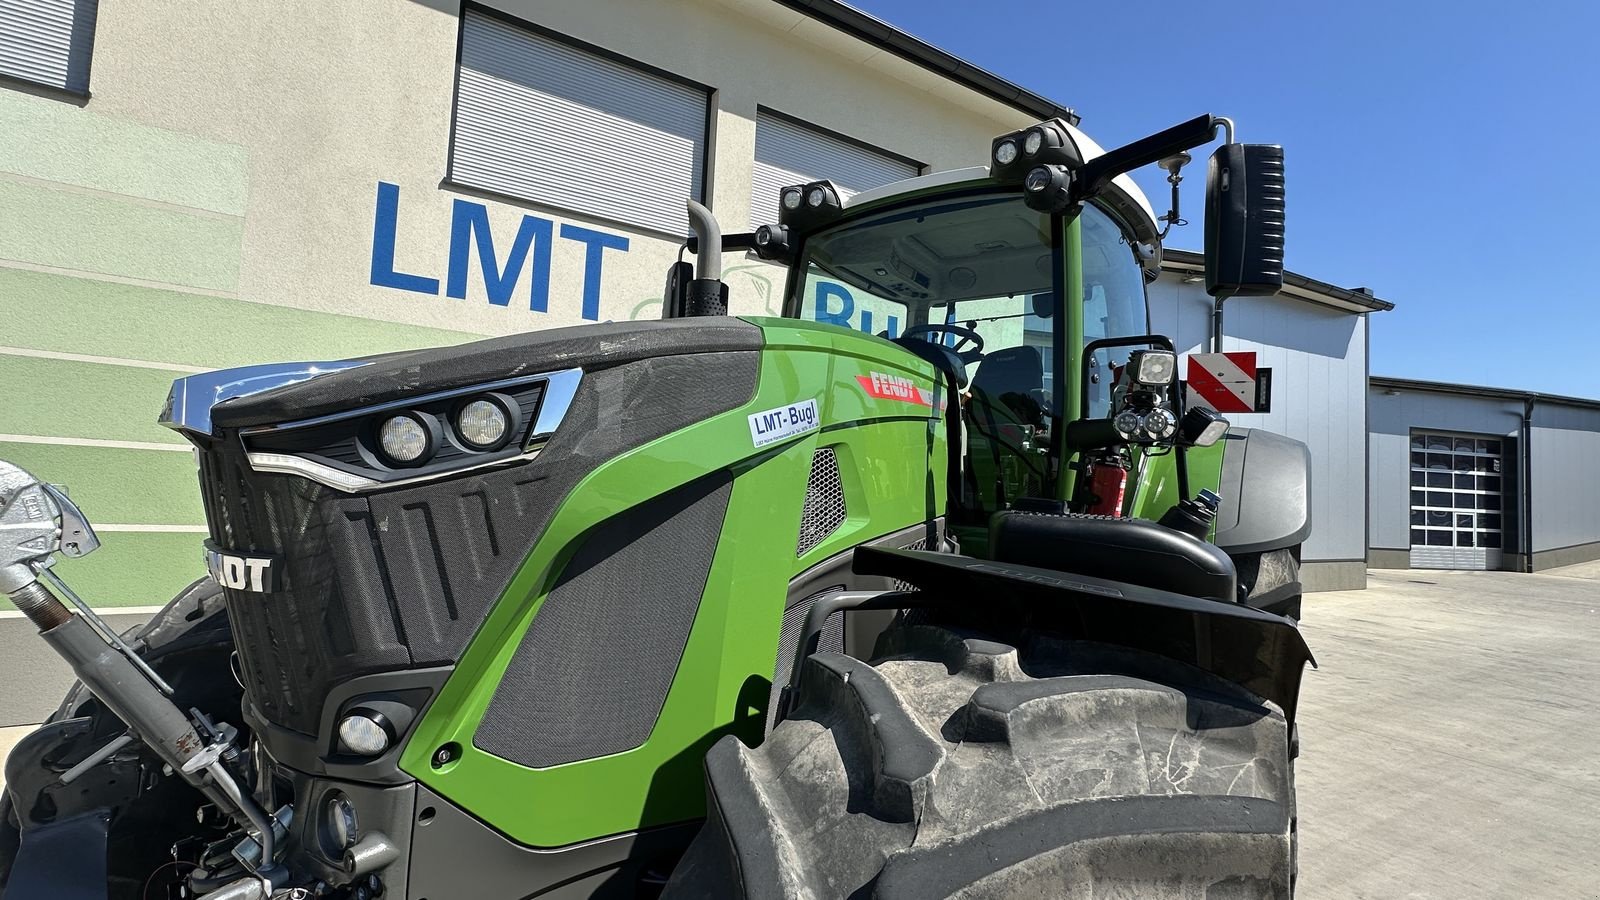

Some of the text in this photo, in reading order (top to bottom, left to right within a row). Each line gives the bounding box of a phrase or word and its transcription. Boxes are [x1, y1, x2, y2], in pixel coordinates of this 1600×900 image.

[370, 181, 630, 321] LMT
[870, 371, 913, 398] FENDT
[206, 550, 272, 593] NDT
